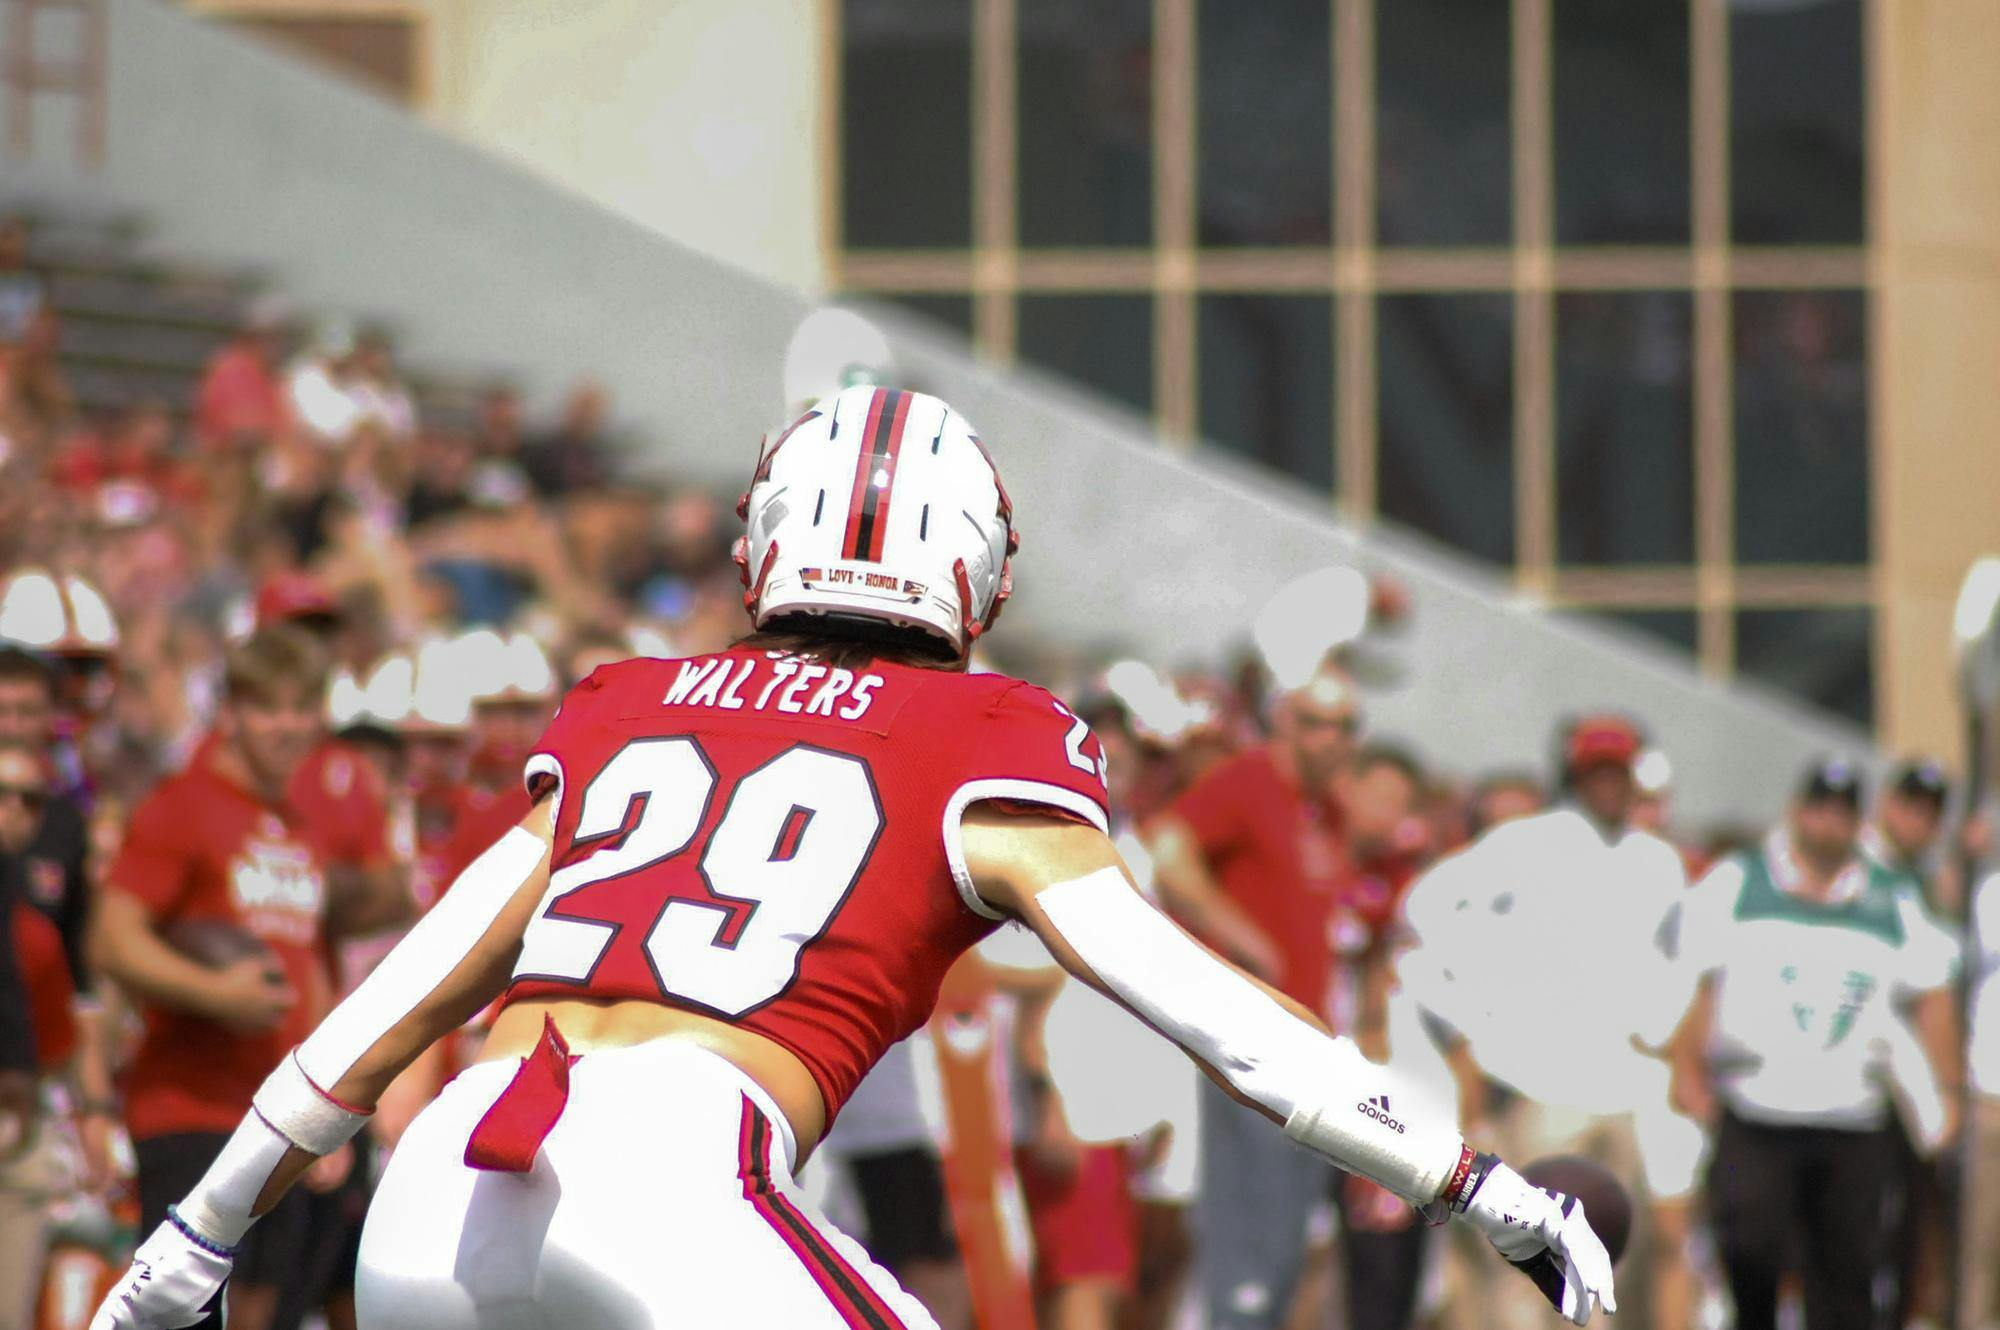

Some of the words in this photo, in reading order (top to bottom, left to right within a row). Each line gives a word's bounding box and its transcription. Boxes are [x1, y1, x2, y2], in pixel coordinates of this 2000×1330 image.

[829, 569, 853, 584] LOVE
[865, 573, 898, 591] HONOR
[662, 658, 884, 721] WALTERS
[510, 734, 887, 1020] 29
